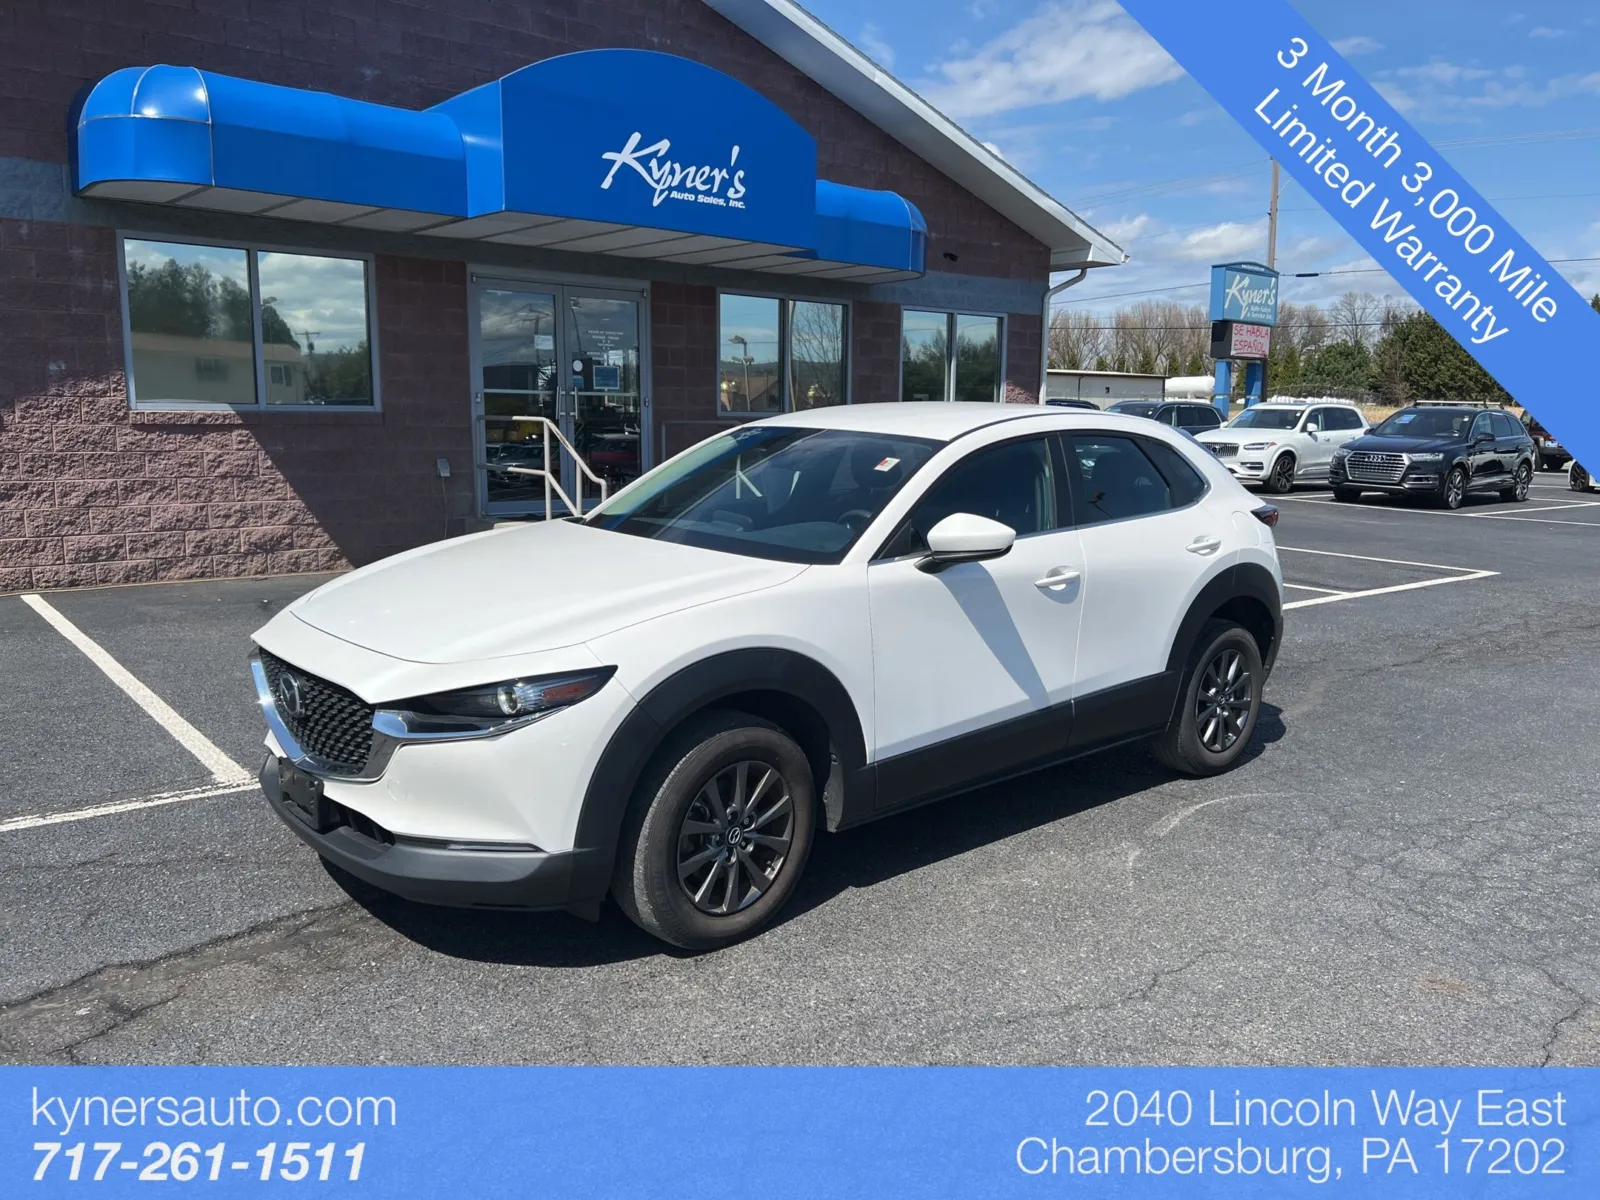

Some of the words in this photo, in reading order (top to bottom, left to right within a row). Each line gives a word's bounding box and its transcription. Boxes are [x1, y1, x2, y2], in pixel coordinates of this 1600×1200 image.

[601, 131, 746, 207] Kyner's
[670, 190, 695, 201] Auto
[697, 194, 727, 207] Sales,
[728, 198, 746, 209] Inc.
[1224, 274, 1276, 319] Kyner's
[1234, 325, 1244, 336] SE
[1246, 326, 1269, 338] HABLA
